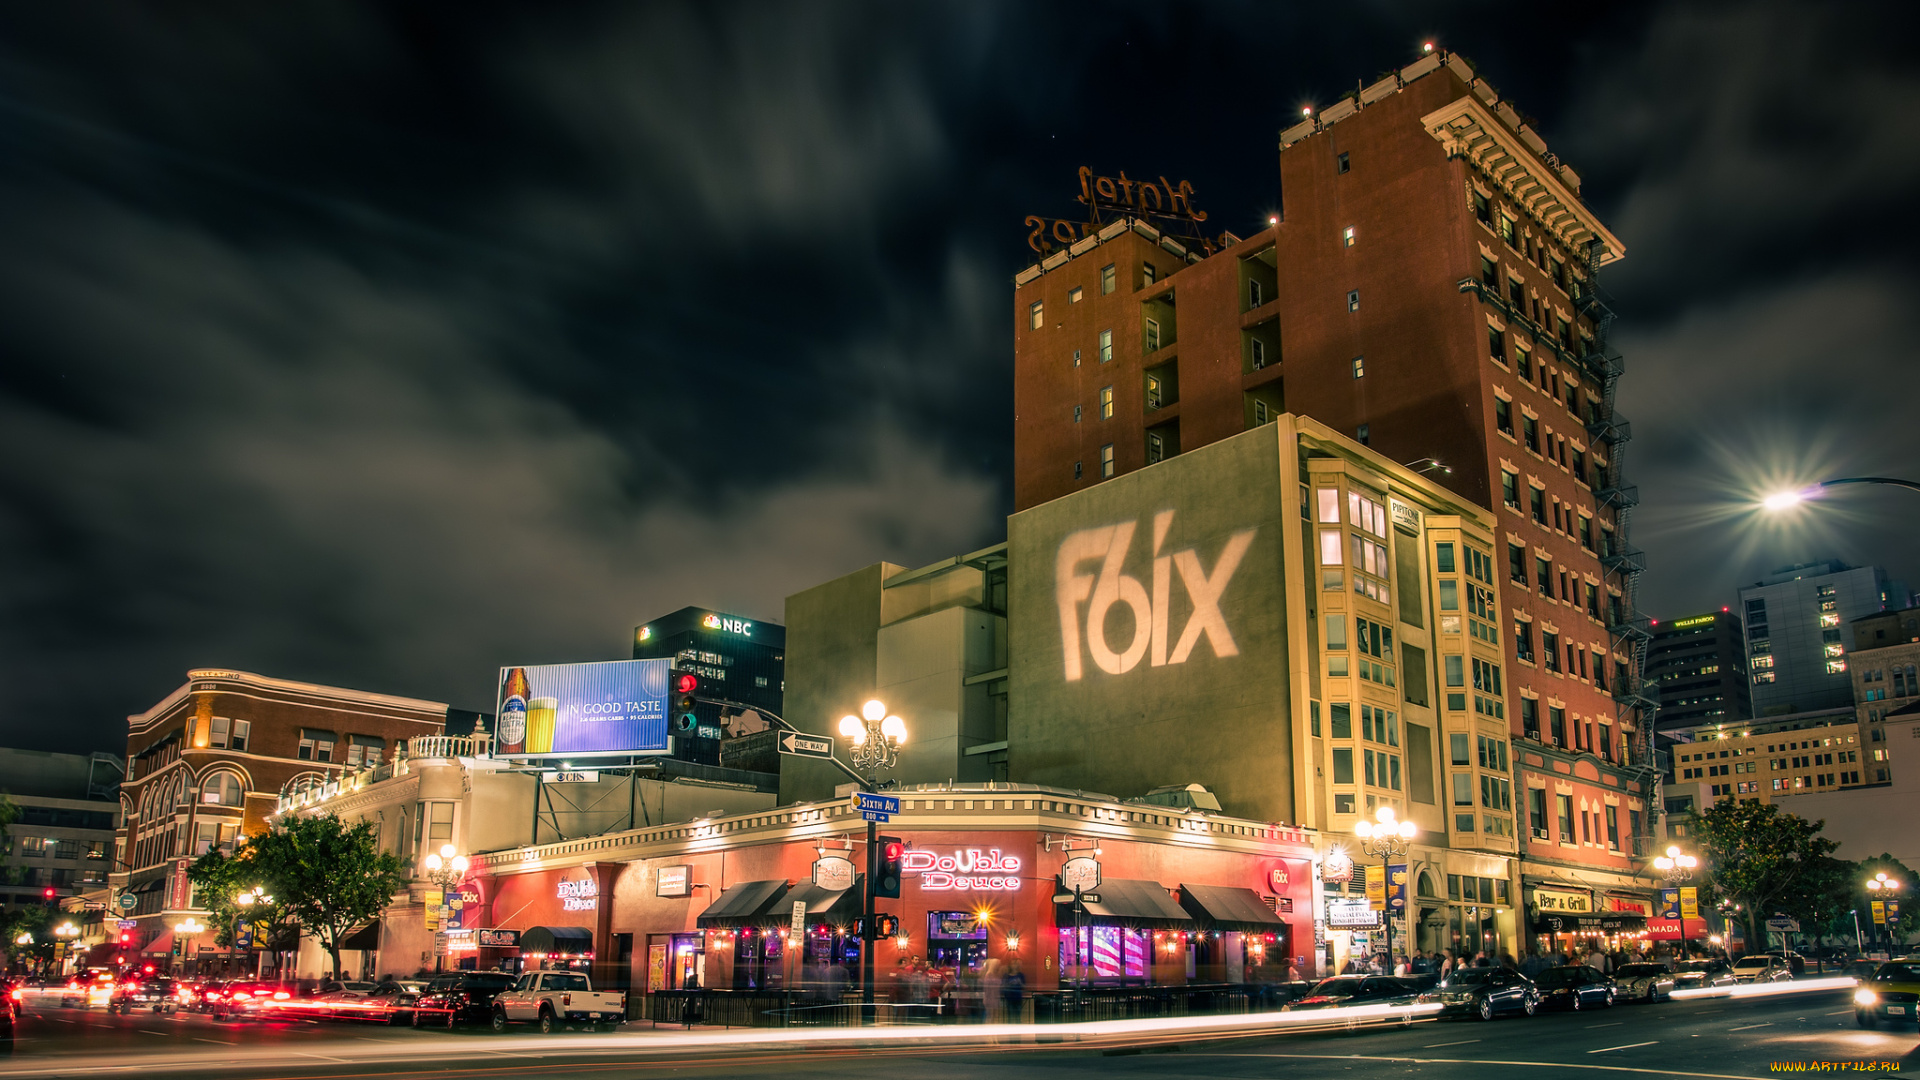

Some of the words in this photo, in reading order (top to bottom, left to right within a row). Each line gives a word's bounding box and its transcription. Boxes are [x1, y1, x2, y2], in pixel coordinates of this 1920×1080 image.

[722, 617, 752, 637] NBC
[566, 704, 579, 716] IN
[583, 702, 622, 714] GOOD
[625, 700, 664, 713] TASTE.
[794, 739, 809, 749] ONE
[810, 742, 824, 751] WAY
[565, 772, 585, 782] CBS
[865, 812, 877, 820] 800
[921, 872, 1020, 890] Deuce
[1539, 893, 1557, 908] Bar
[1559, 898, 1565, 909] &
[1567, 896, 1586, 911] Grill
[1647, 925, 1680, 933] AMADA
